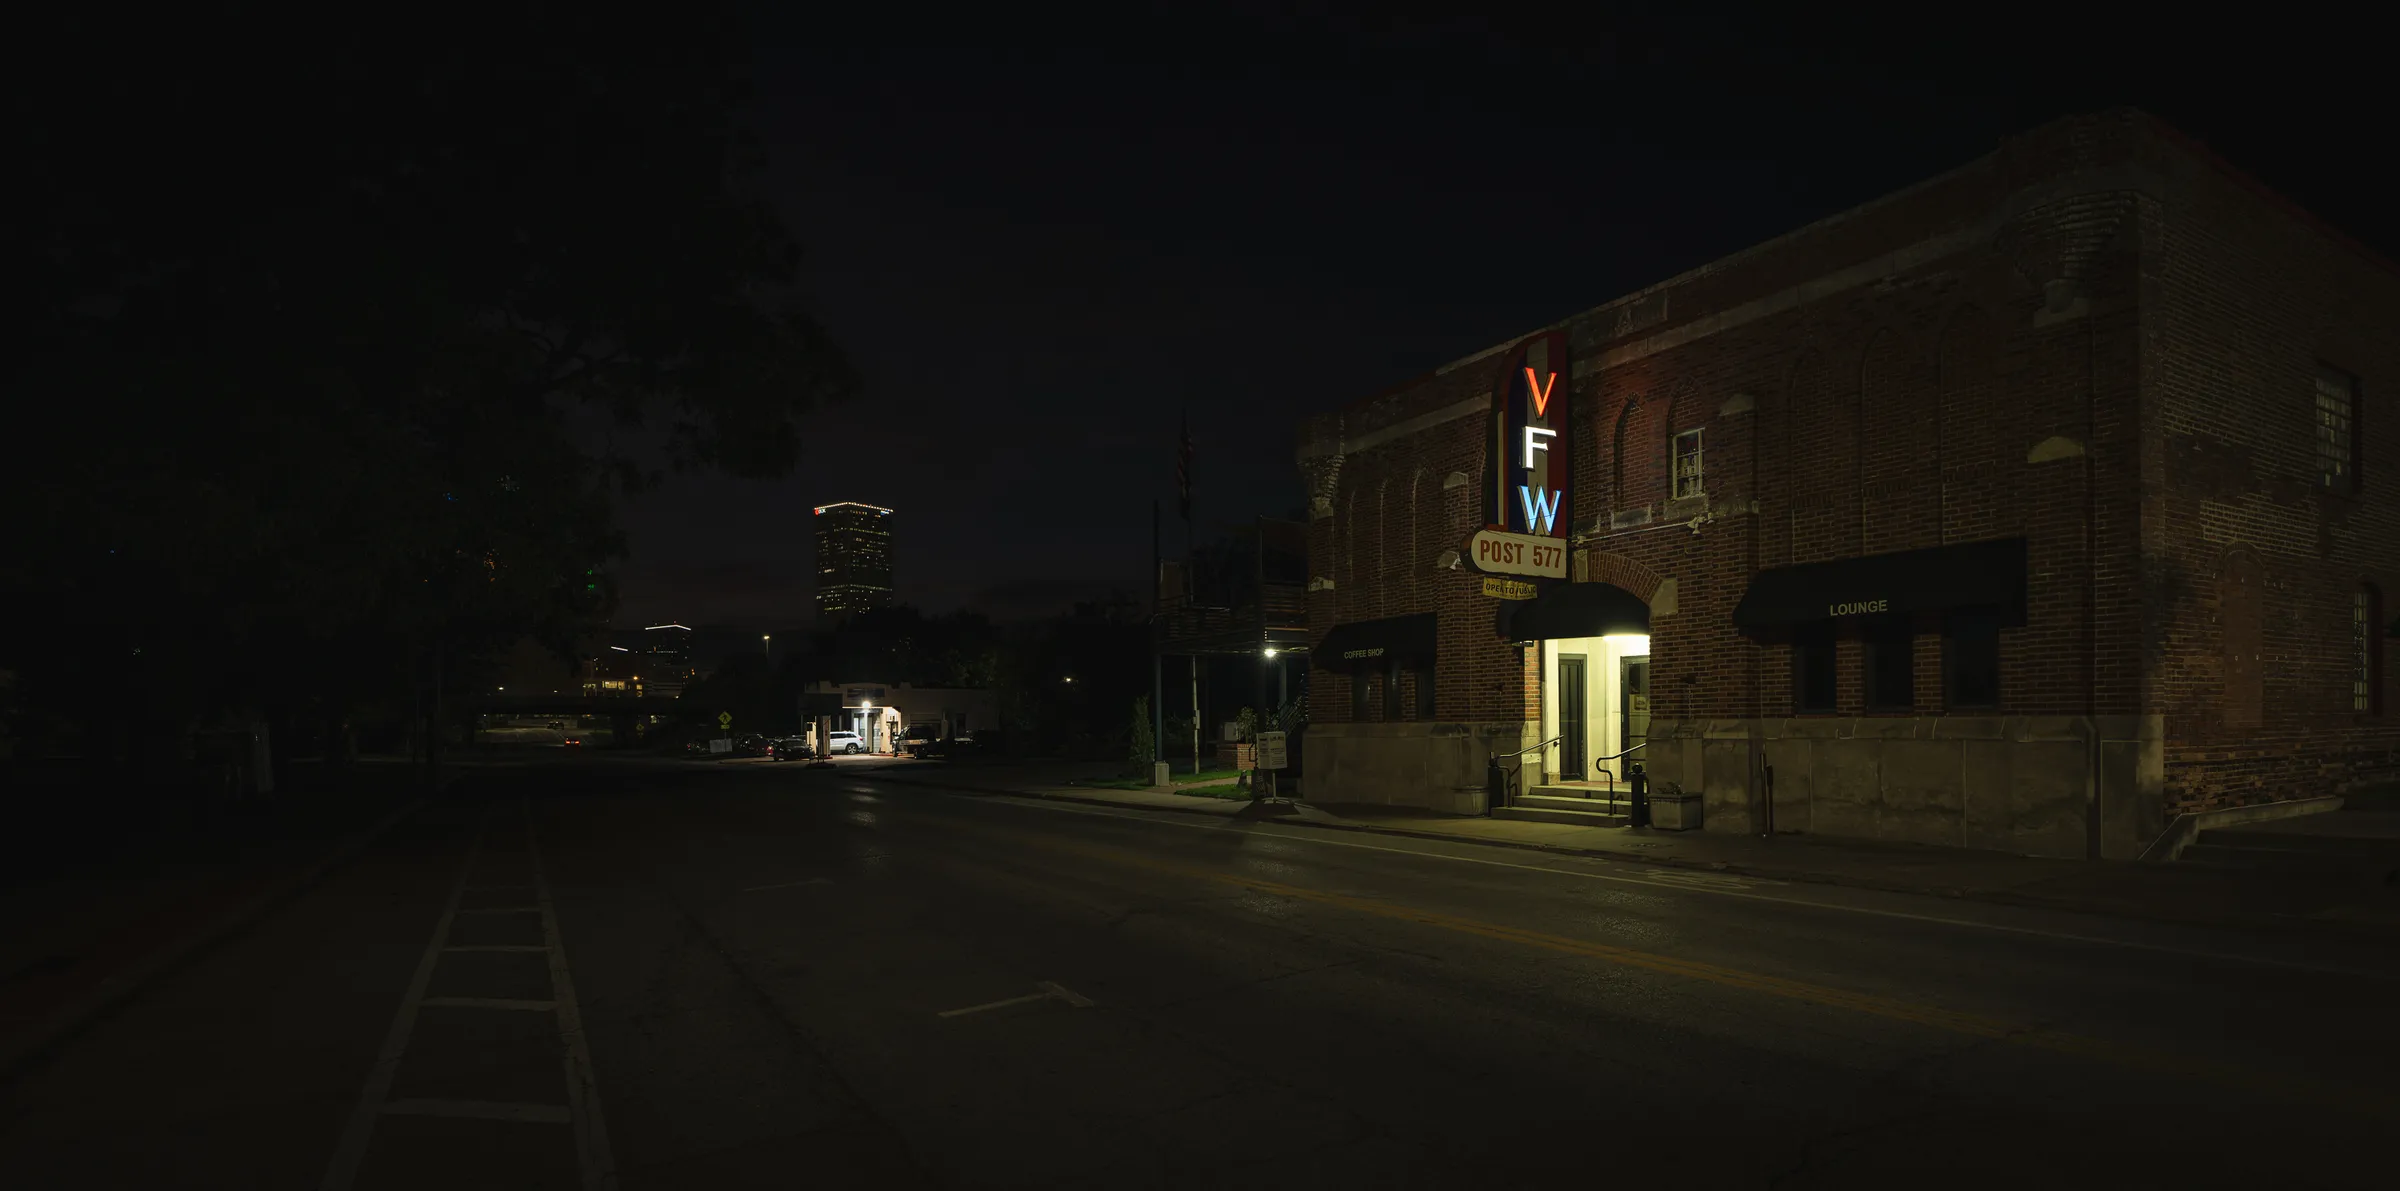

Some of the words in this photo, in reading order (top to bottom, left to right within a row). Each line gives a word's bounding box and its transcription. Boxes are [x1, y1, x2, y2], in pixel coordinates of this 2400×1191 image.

[1519, 367, 1561, 534] VFW
[1480, 539, 1524, 565] POST
[1533, 547, 1562, 569] 577
[1485, 583, 1504, 593] OPEN
[1504, 586, 1515, 595] TO
[1829, 599, 1889, 616] LOUNGE
[1343, 650, 1367, 660] COFFEE
[1367, 647, 1384, 657] SHOP
